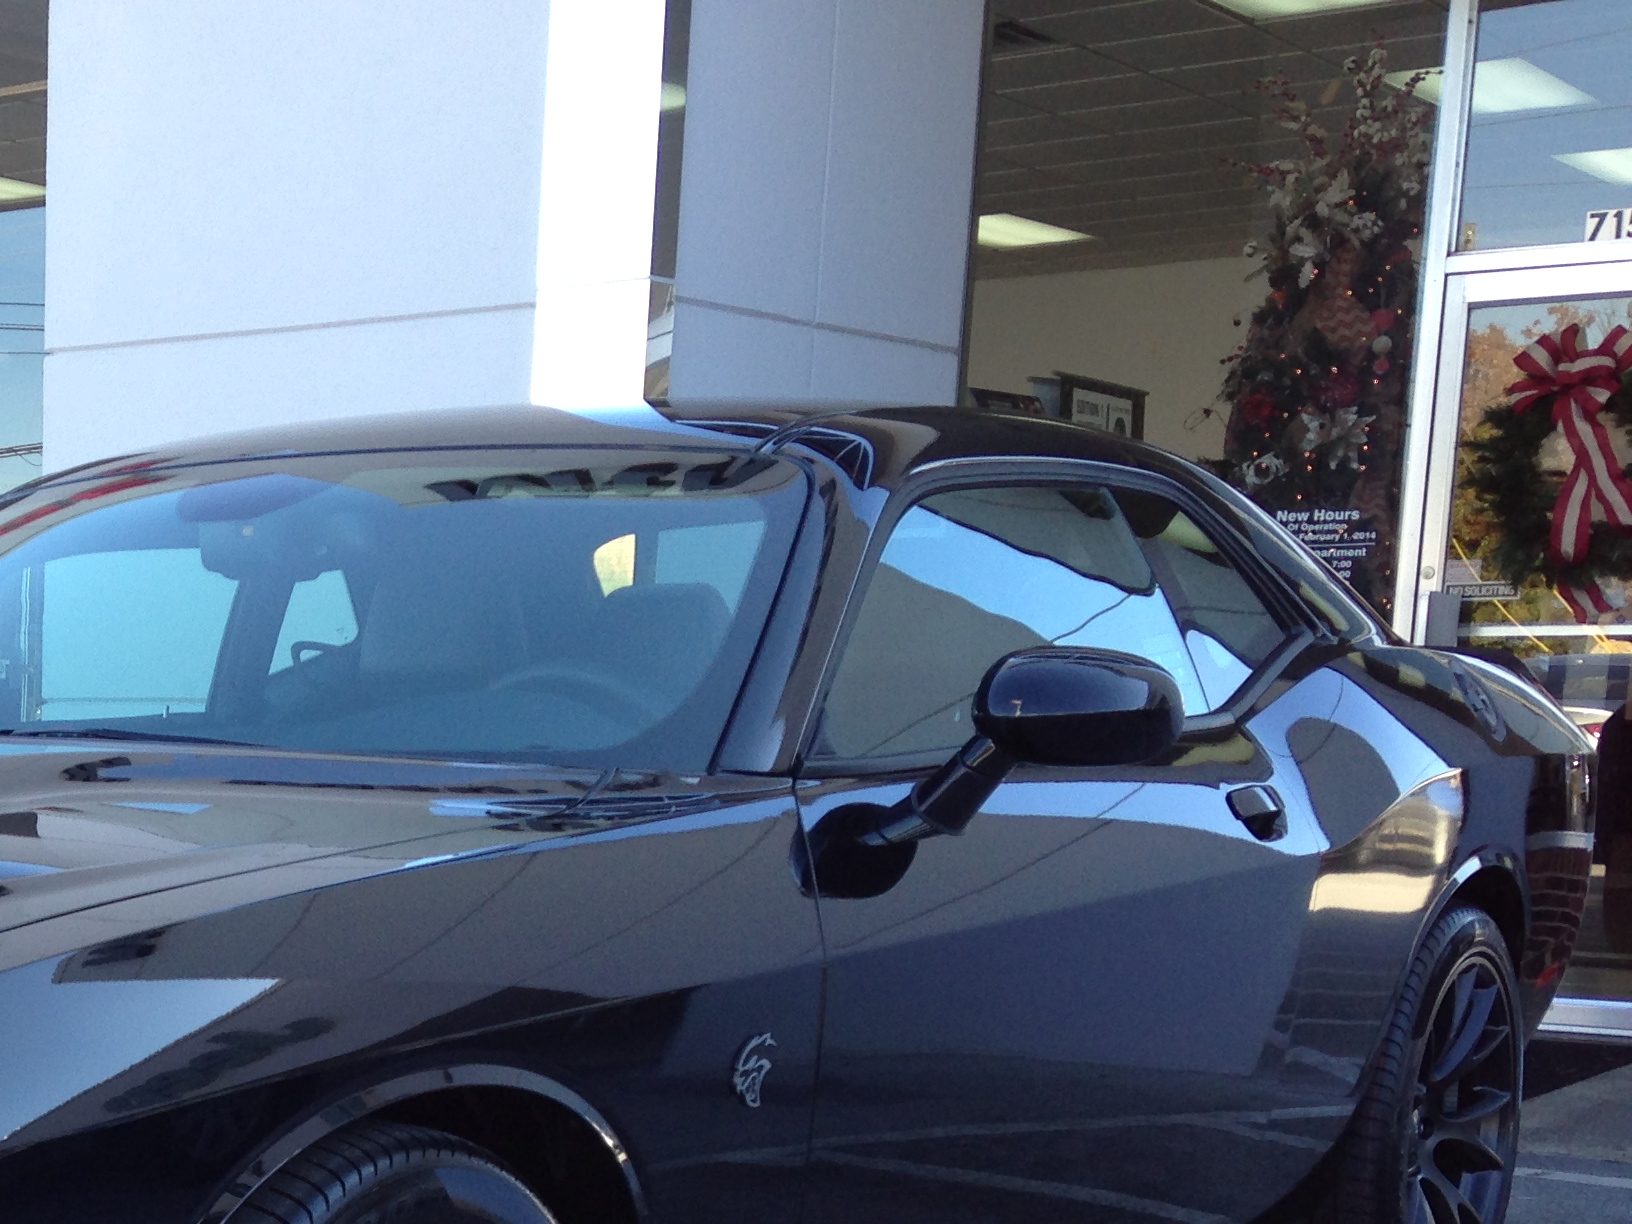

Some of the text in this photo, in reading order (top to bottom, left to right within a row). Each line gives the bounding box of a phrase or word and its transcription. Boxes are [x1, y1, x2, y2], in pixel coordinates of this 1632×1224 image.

[1276, 509, 1360, 521] New Hours
[1288, 522, 1348, 532] Of Operation
[1299, 532, 1341, 541] February
[1352, 531, 1376, 540] 2014
[1464, 584, 1515, 596] SOLICITING
